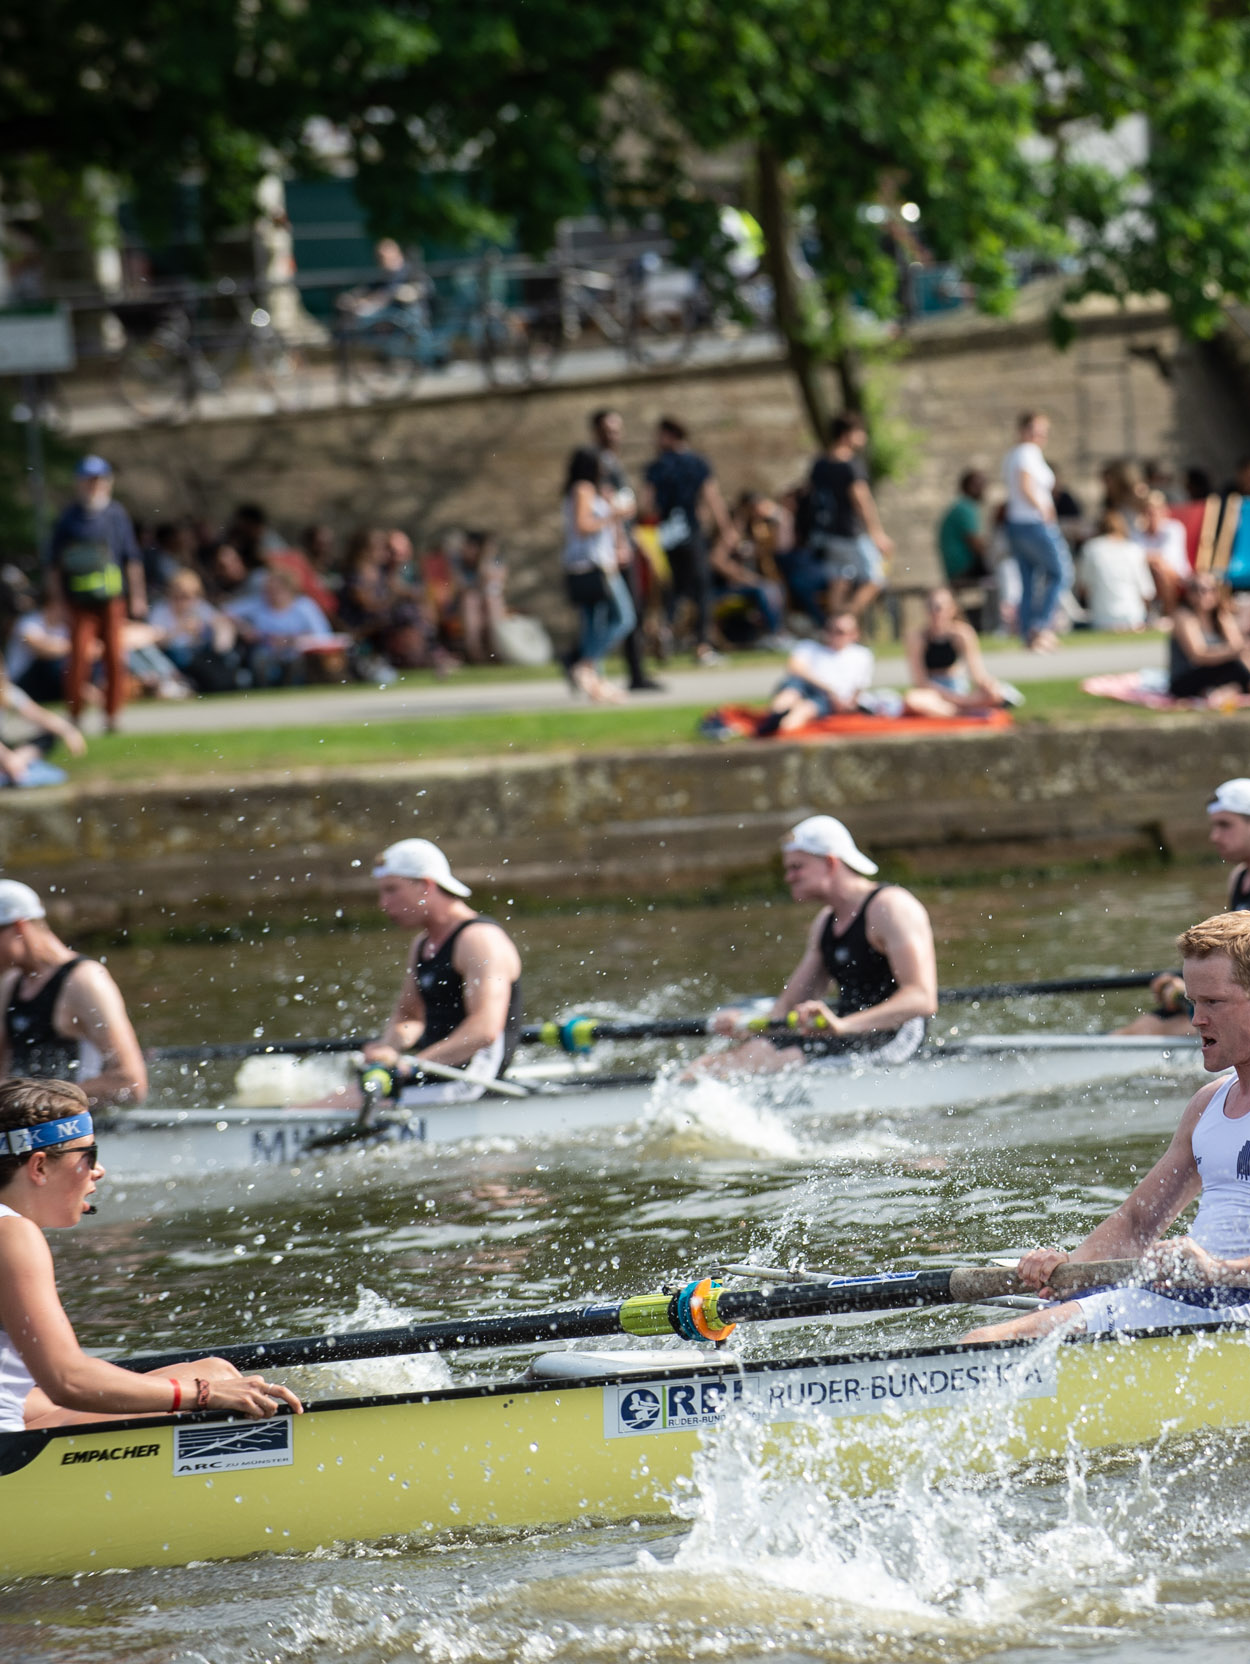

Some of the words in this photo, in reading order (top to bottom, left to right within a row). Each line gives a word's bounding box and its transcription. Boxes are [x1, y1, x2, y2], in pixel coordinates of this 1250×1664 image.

[56, 1120, 82, 1138] NK
[61, 1444, 161, 1465] EMPACHER
[178, 1461, 223, 1473] ARC
